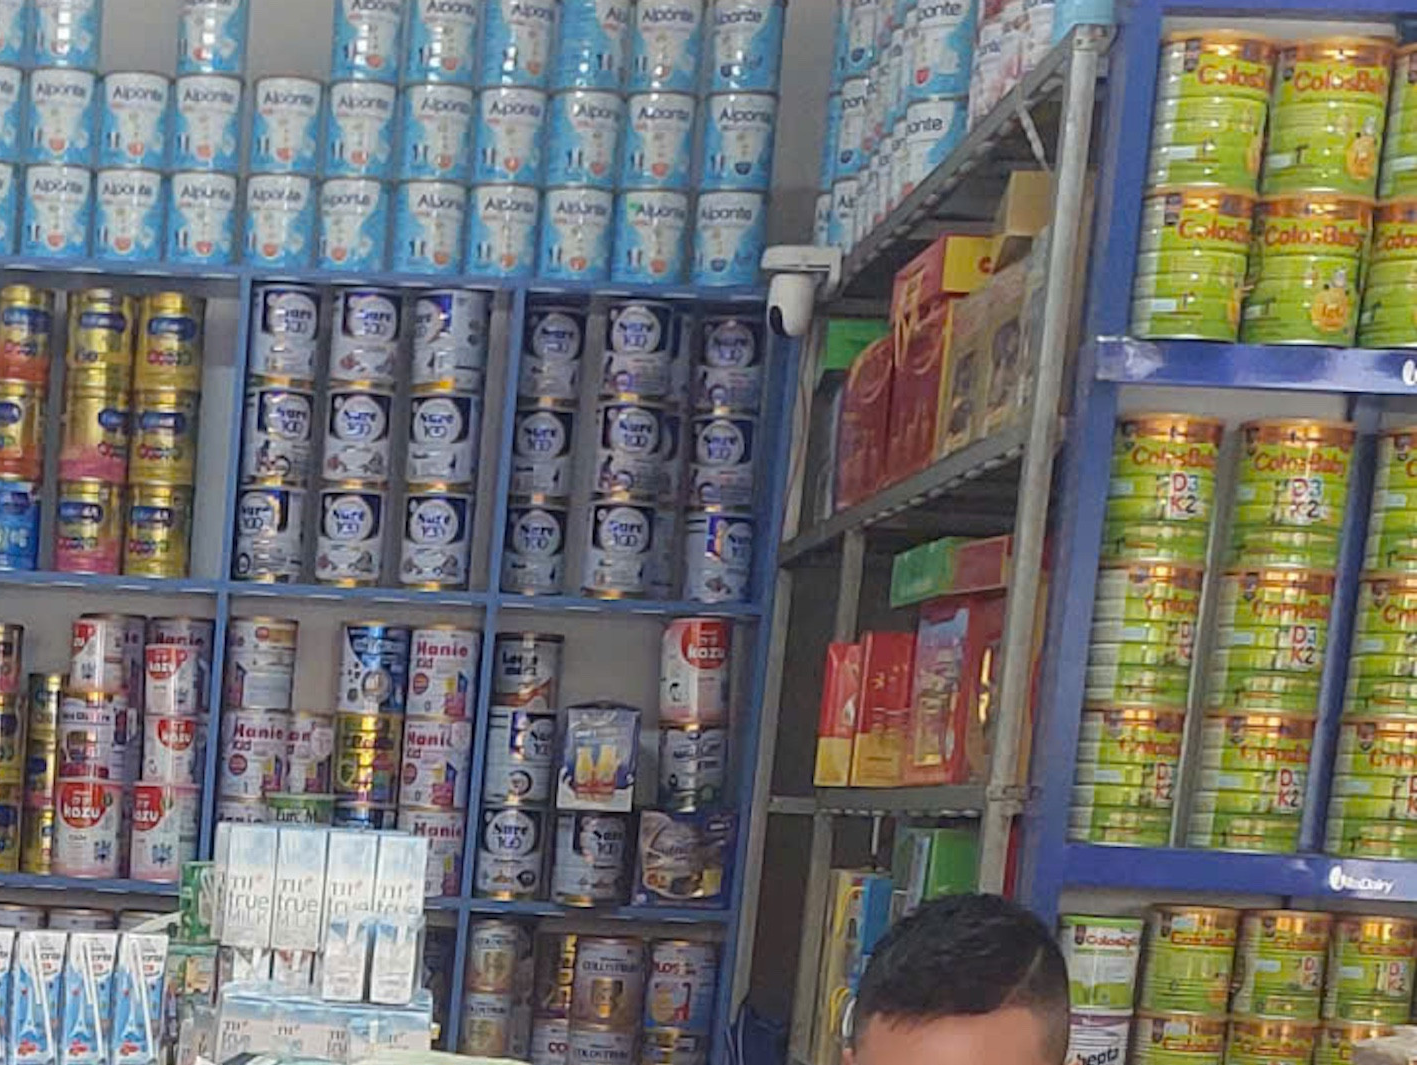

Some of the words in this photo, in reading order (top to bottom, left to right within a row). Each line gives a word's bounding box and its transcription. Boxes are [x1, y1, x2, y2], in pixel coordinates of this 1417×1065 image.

[36, 81, 89, 99] Alponte
[113, 83, 164, 102] Alponte
[183, 87, 235, 105] Alponte
[264, 90, 314, 109] Alponte
[338, 95, 388, 113] Alponte
[422, 96, 470, 115] Alponte
[489, 100, 541, 119] Alponte
[639, 105, 689, 124] Alponte
[720, 108, 771, 128] Alponte
[33, 177, 86, 197] Alponte
[102, 181, 153, 200] Alponte
[182, 184, 231, 202] Alponte
[252, 188, 302, 206] Alponte
[418, 195, 462, 213] Alponte
[485, 198, 534, 216] Alponte
[556, 202, 606, 219] Alponte
[637, 205, 687, 224] Alponte
[700, 208, 752, 226] Alponte
[1170, 471, 1200, 493] D3
[416, 639, 469, 658] Hanie
[233, 723, 283, 741] Hanie
[62, 802, 101, 820] kazu
[134, 808, 160, 823] azu
